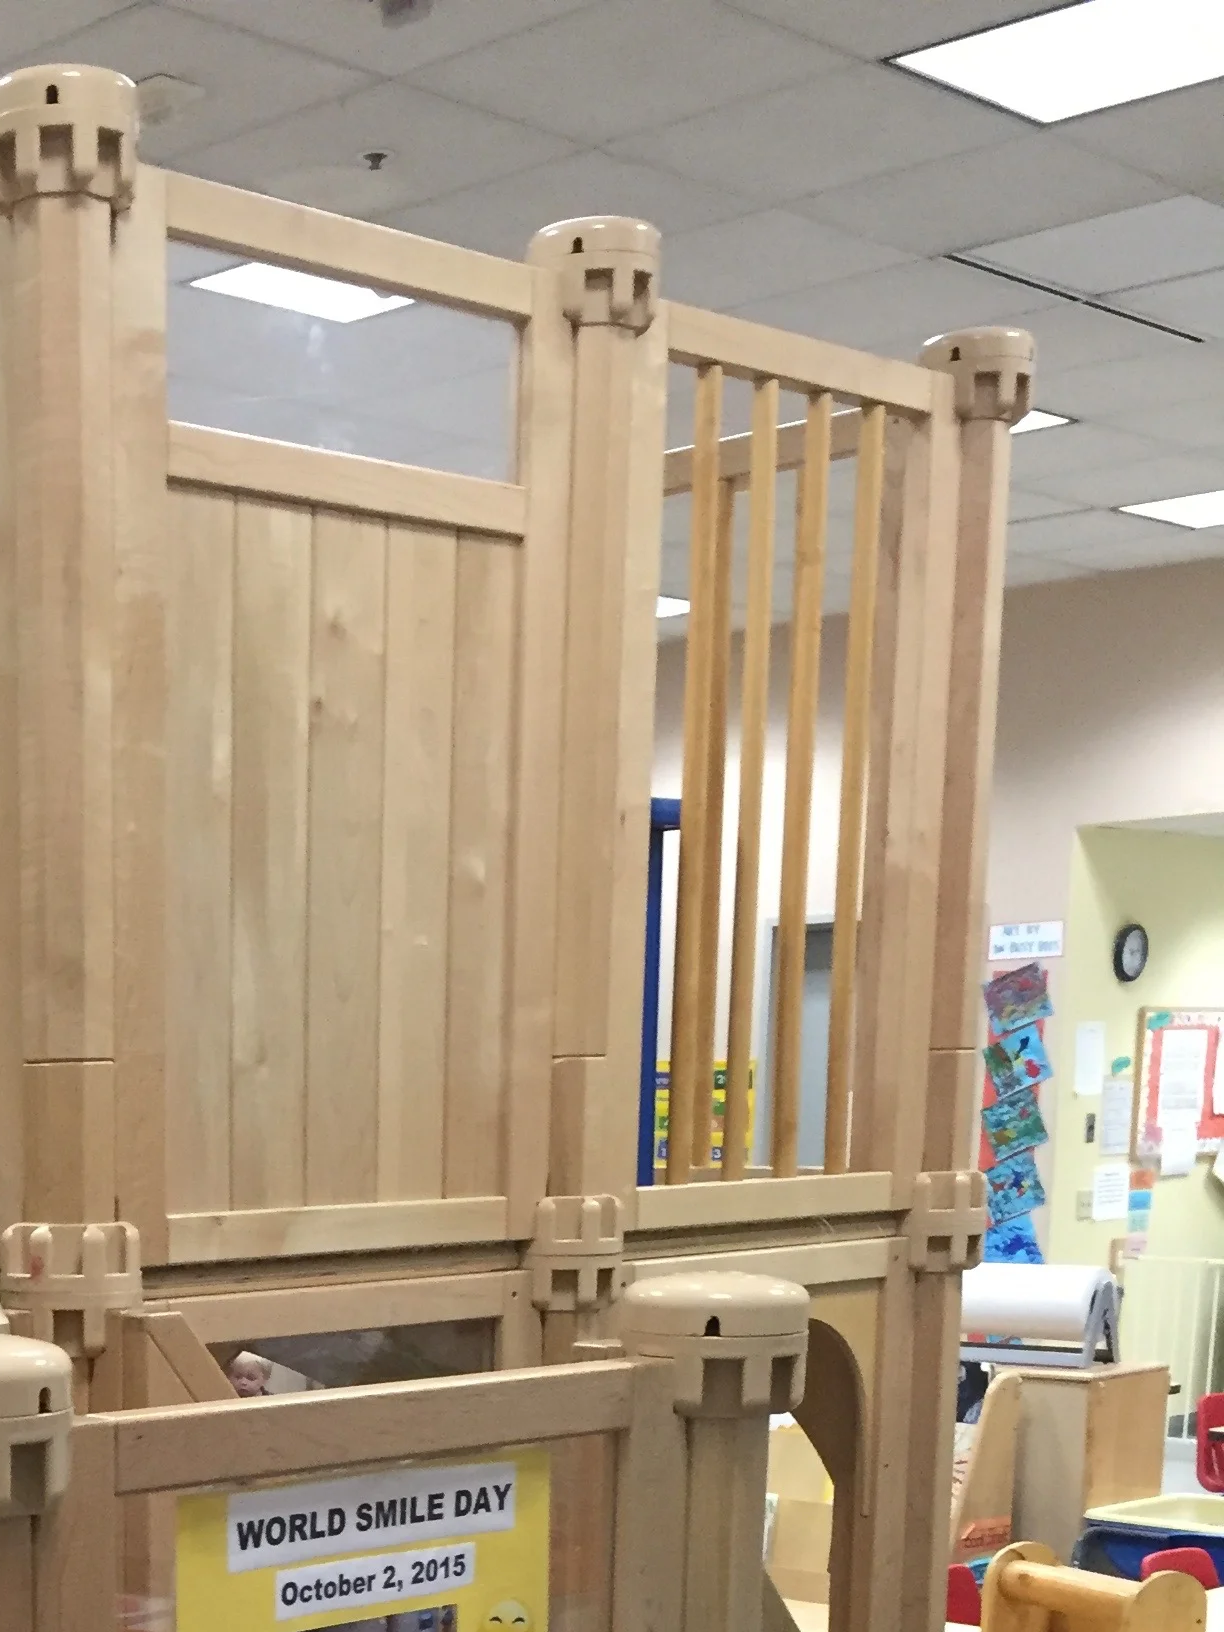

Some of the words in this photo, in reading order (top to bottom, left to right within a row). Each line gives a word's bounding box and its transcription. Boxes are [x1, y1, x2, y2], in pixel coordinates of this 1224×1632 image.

[237, 1508, 346, 1550] WORLD
[356, 1492, 445, 1531] SMILE
[454, 1483, 512, 1516] DAY
[281, 1574, 376, 1607] October
[383, 1565, 403, 1592] 2,
[411, 1554, 466, 1584] 2015
